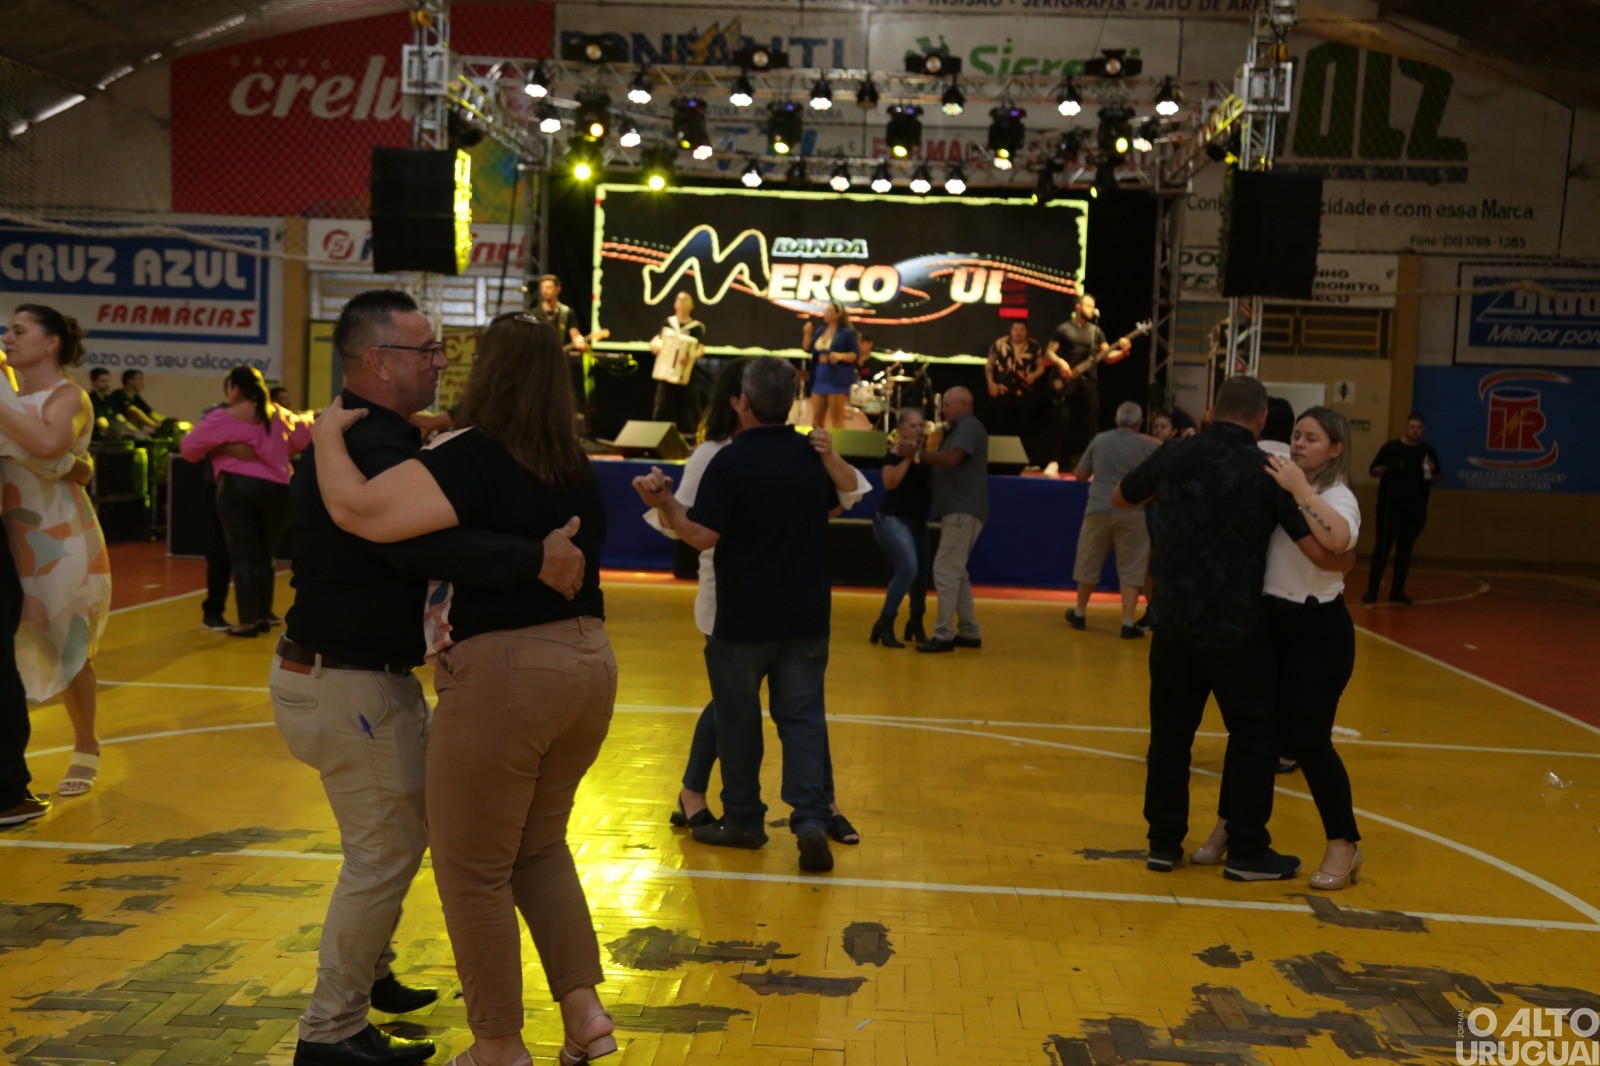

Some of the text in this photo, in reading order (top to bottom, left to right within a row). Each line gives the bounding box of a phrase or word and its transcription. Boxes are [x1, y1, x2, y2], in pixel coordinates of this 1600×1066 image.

[1395, 203, 1432, 217] com
[1437, 204, 1477, 218] essa
[1482, 199, 1533, 219] Marca
[772, 236, 869, 259] BANDA
[1, 243, 248, 291] CRUZ AZUL
[97, 301, 255, 328] FARMÁCIAS
[1487, 323, 1560, 343] Melhor
[155, 354, 188, 369] seu
